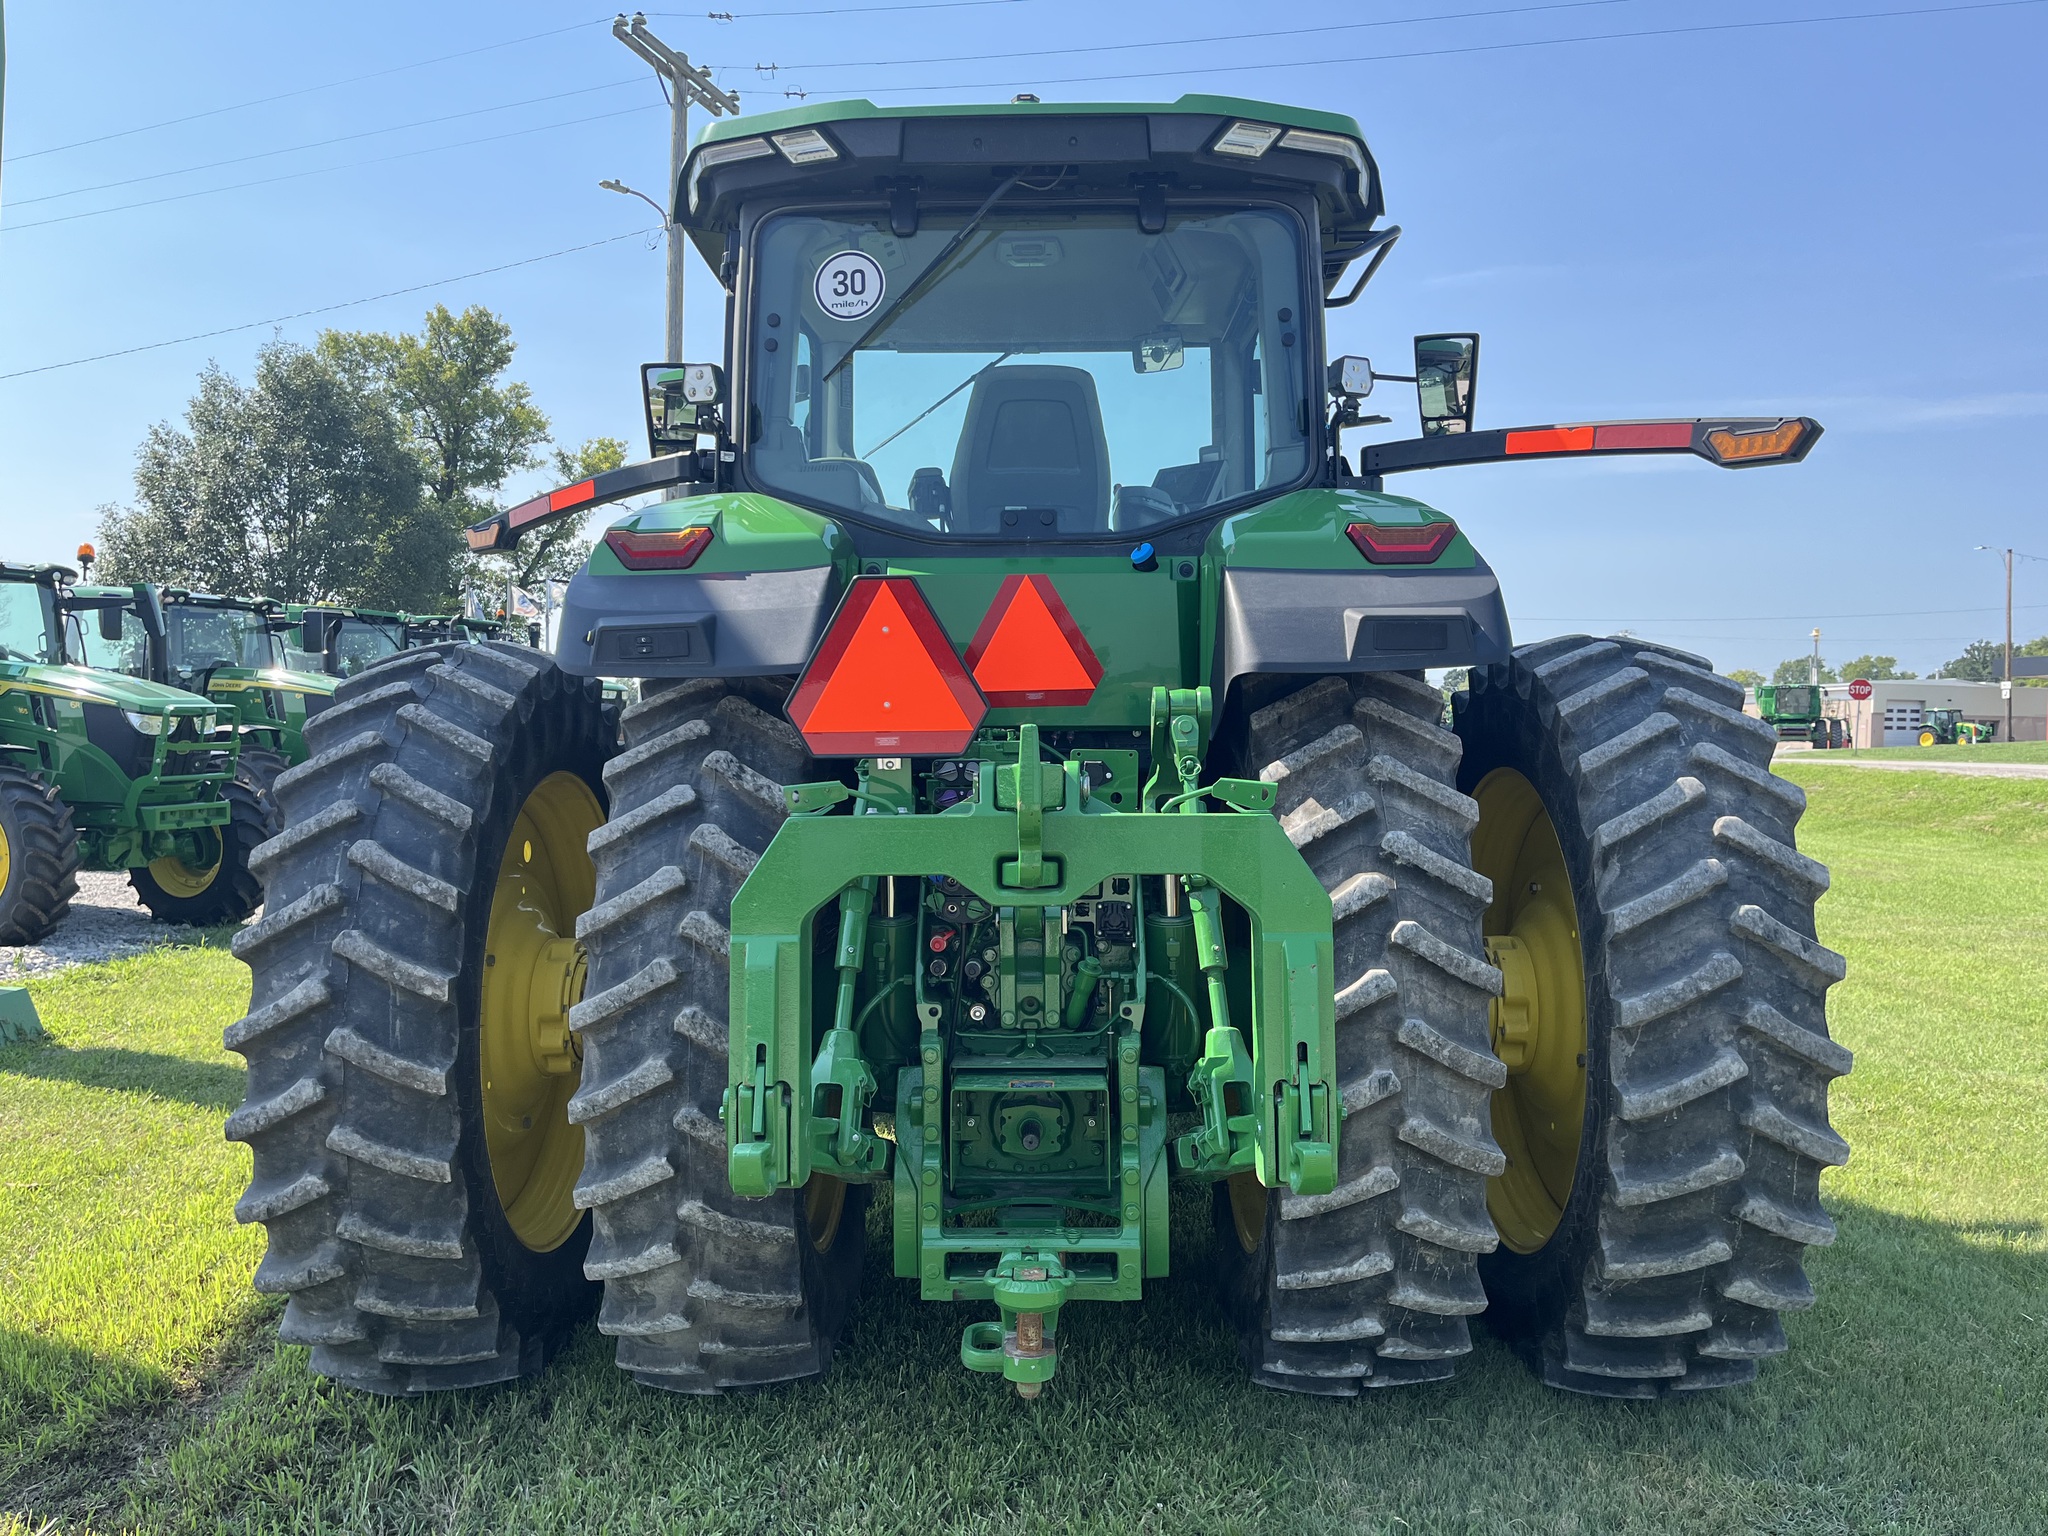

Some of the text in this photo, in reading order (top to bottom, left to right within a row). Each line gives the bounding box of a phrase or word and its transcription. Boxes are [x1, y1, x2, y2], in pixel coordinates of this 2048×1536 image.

[832, 269, 866, 297] 30
[831, 299, 869, 309] mile/h
[1850, 685, 1871, 695] STOP
[69, 701, 81, 709] 6R
